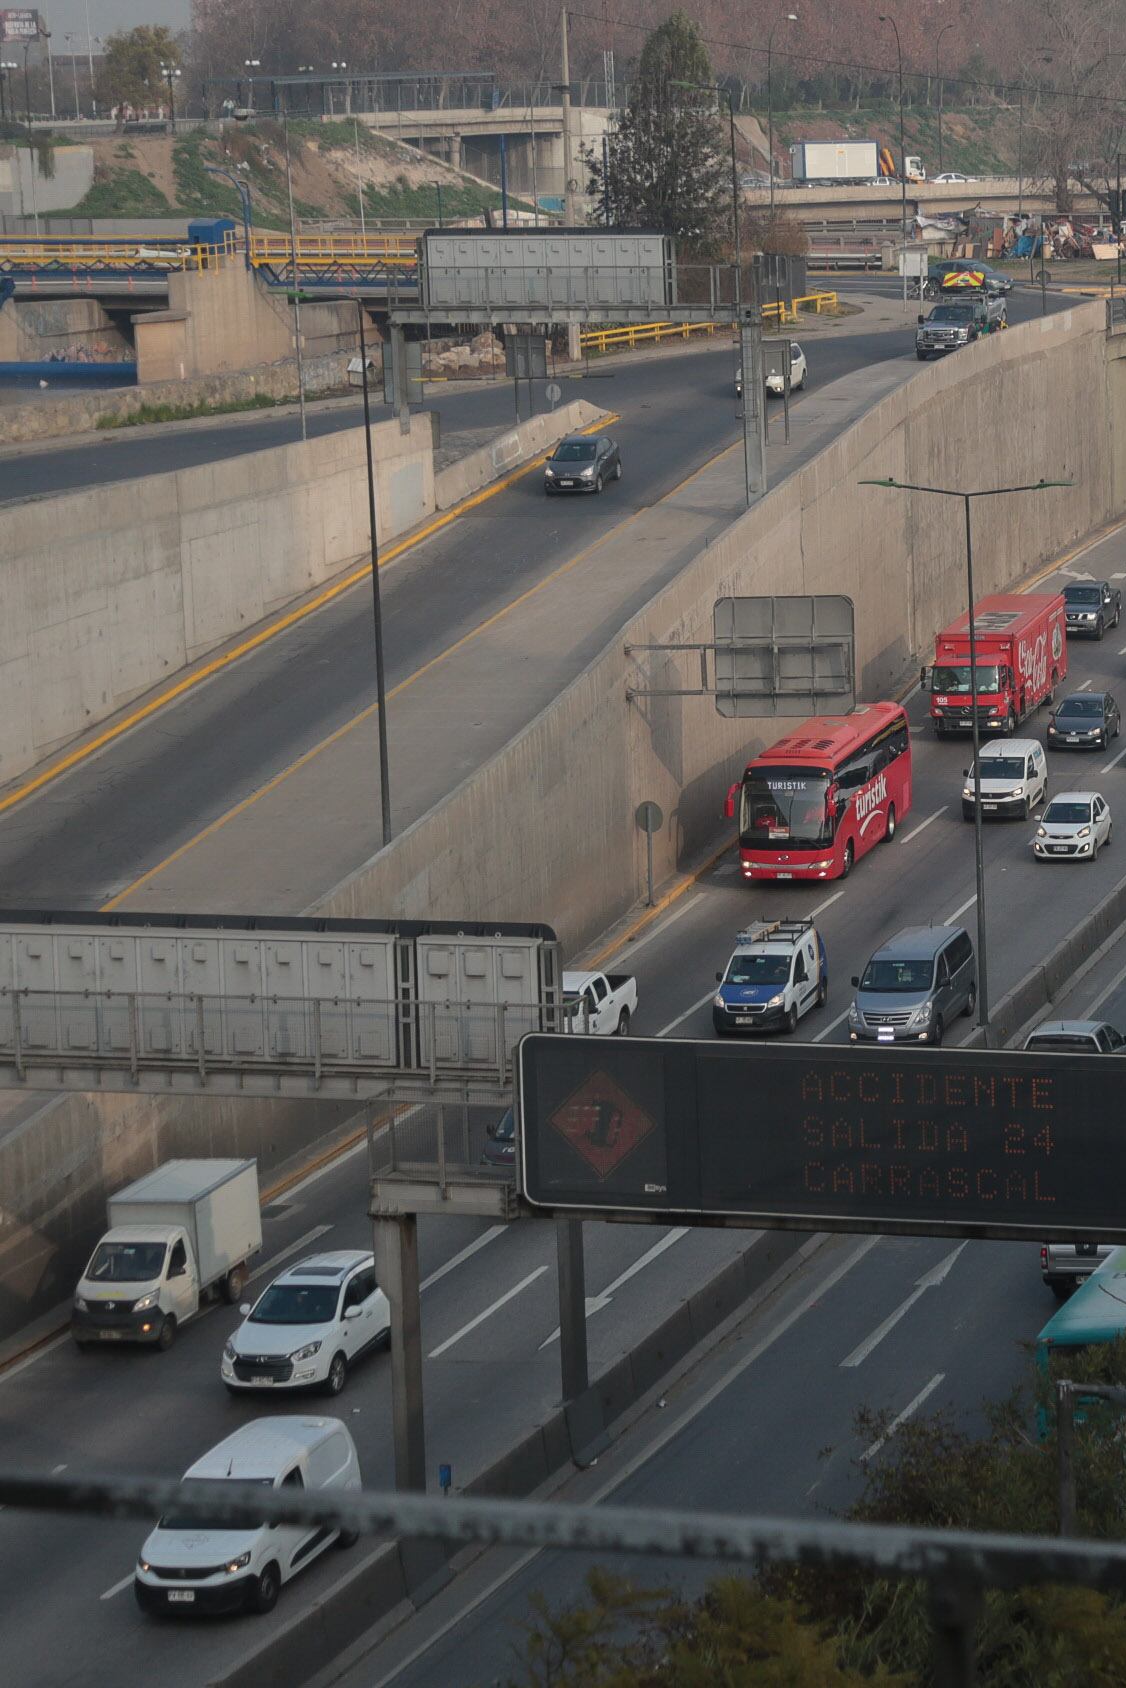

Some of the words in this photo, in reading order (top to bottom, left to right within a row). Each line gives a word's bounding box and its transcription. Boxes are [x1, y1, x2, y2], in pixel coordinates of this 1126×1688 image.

[767, 781, 807, 790] TURISTIK
[855, 773, 888, 821] turistik
[801, 1069, 1056, 1110] ACCIDENTE
[803, 1114, 969, 1153] SALIDA
[1004, 1122, 1057, 1155] 24
[803, 1160, 1057, 1201] CARRASCAL
